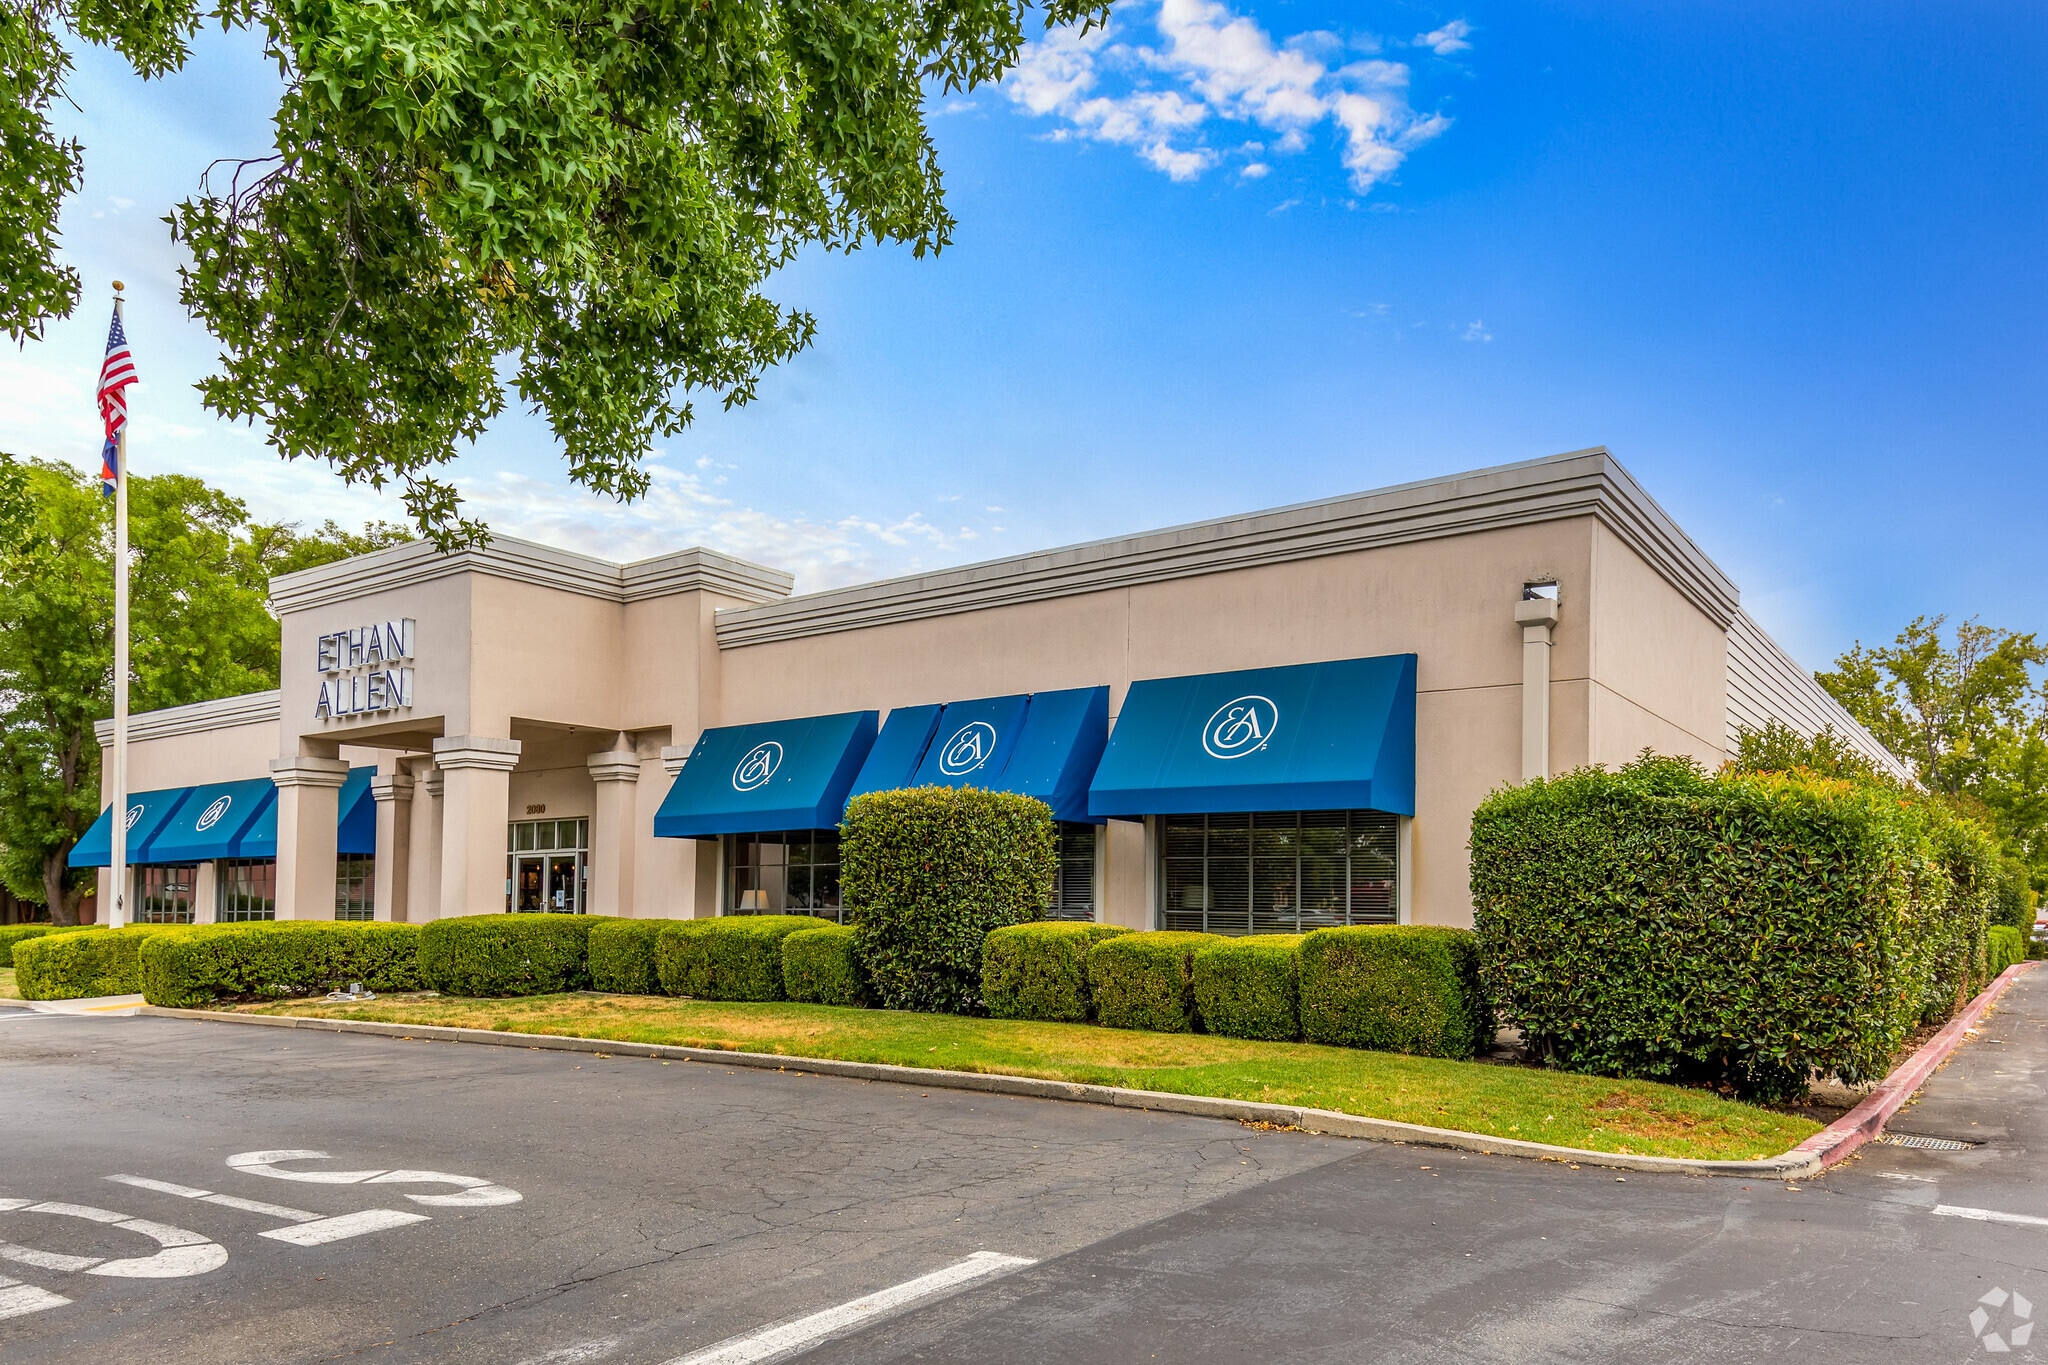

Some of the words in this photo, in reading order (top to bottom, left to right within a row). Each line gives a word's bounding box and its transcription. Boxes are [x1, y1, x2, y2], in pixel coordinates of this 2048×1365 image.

[317, 618, 406, 673] ETHAN
[314, 667, 405, 719] ALLEN
[0, 1149, 524, 1320] STO
